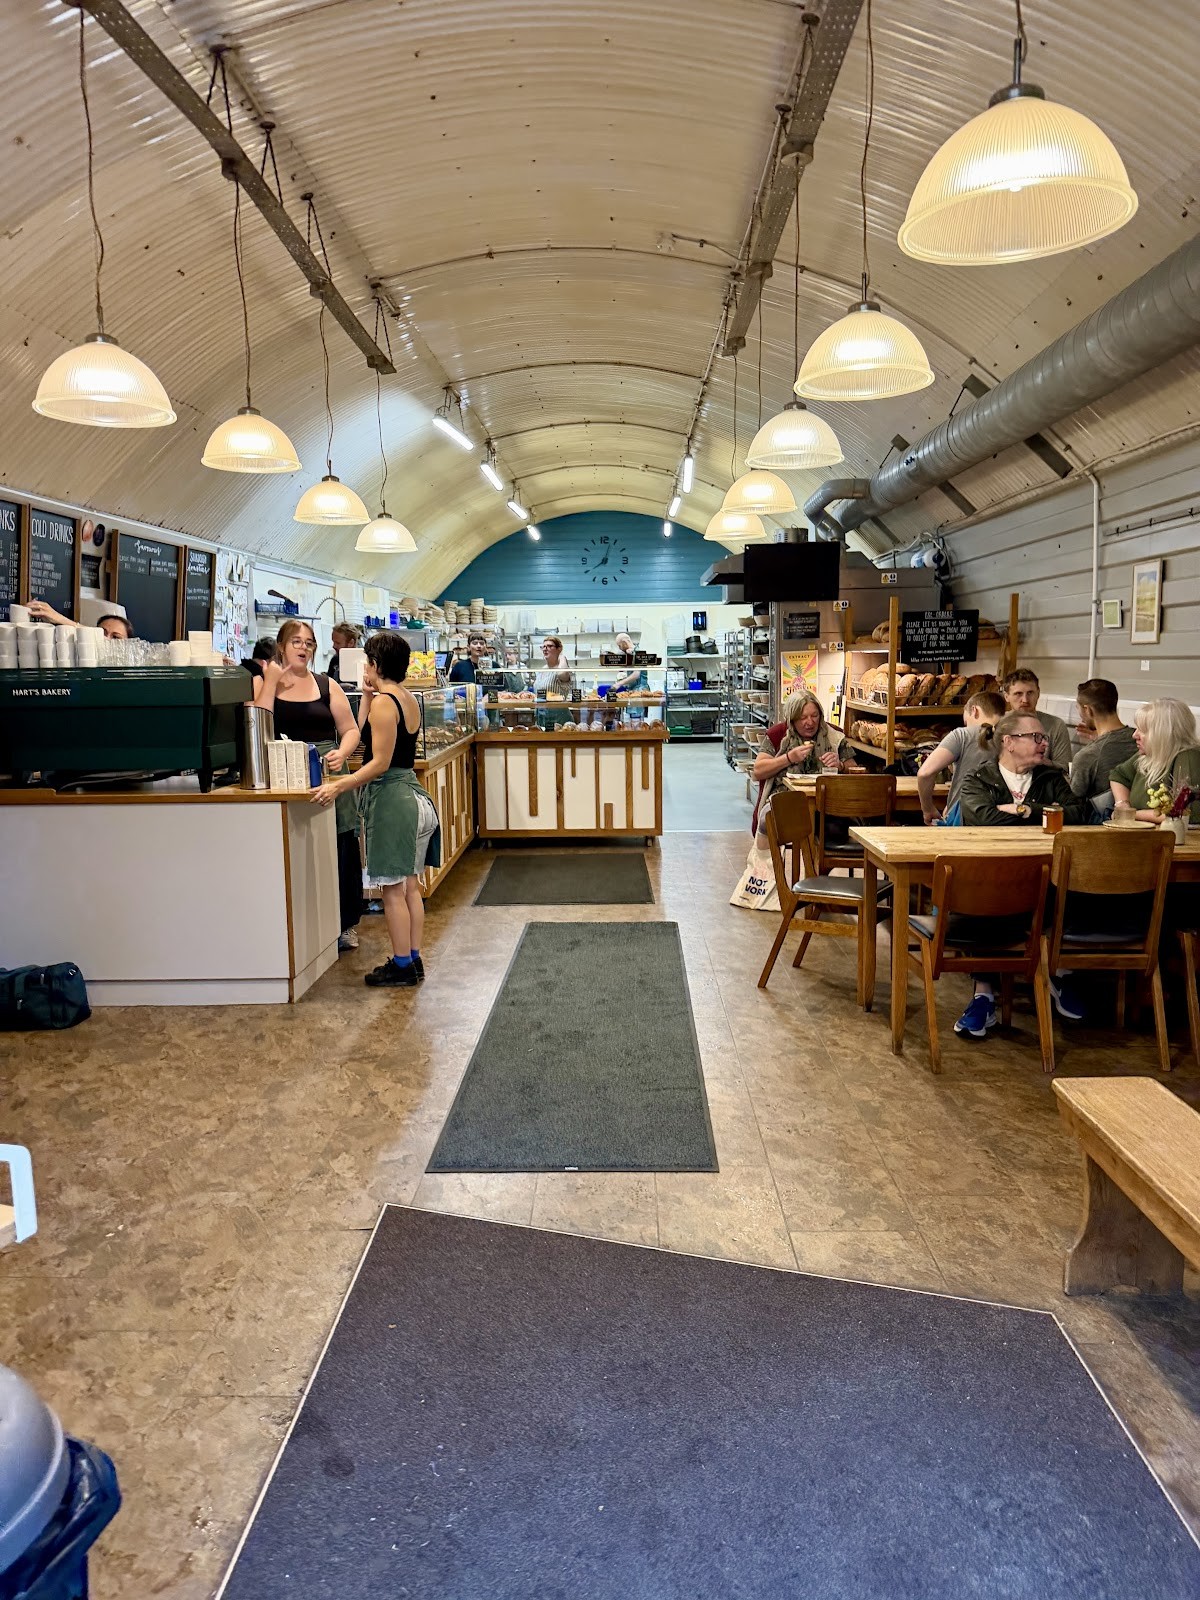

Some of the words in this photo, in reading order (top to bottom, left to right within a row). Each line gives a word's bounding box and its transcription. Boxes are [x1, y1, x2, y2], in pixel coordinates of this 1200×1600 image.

[31, 518, 47, 538] COLD
[49, 521, 74, 545] DRINKS
[600, 536, 610, 544] 12
[581, 557, 588, 565] 9
[622, 557, 629, 565] 3
[601, 577, 608, 585] 6
[906, 620, 920, 628] PLEASE
[912, 634, 928, 642] COLLECT
[12, 688, 40, 696] HART'S
[41, 688, 72, 696] BAKERY
[749, 876, 768, 887] NOT
